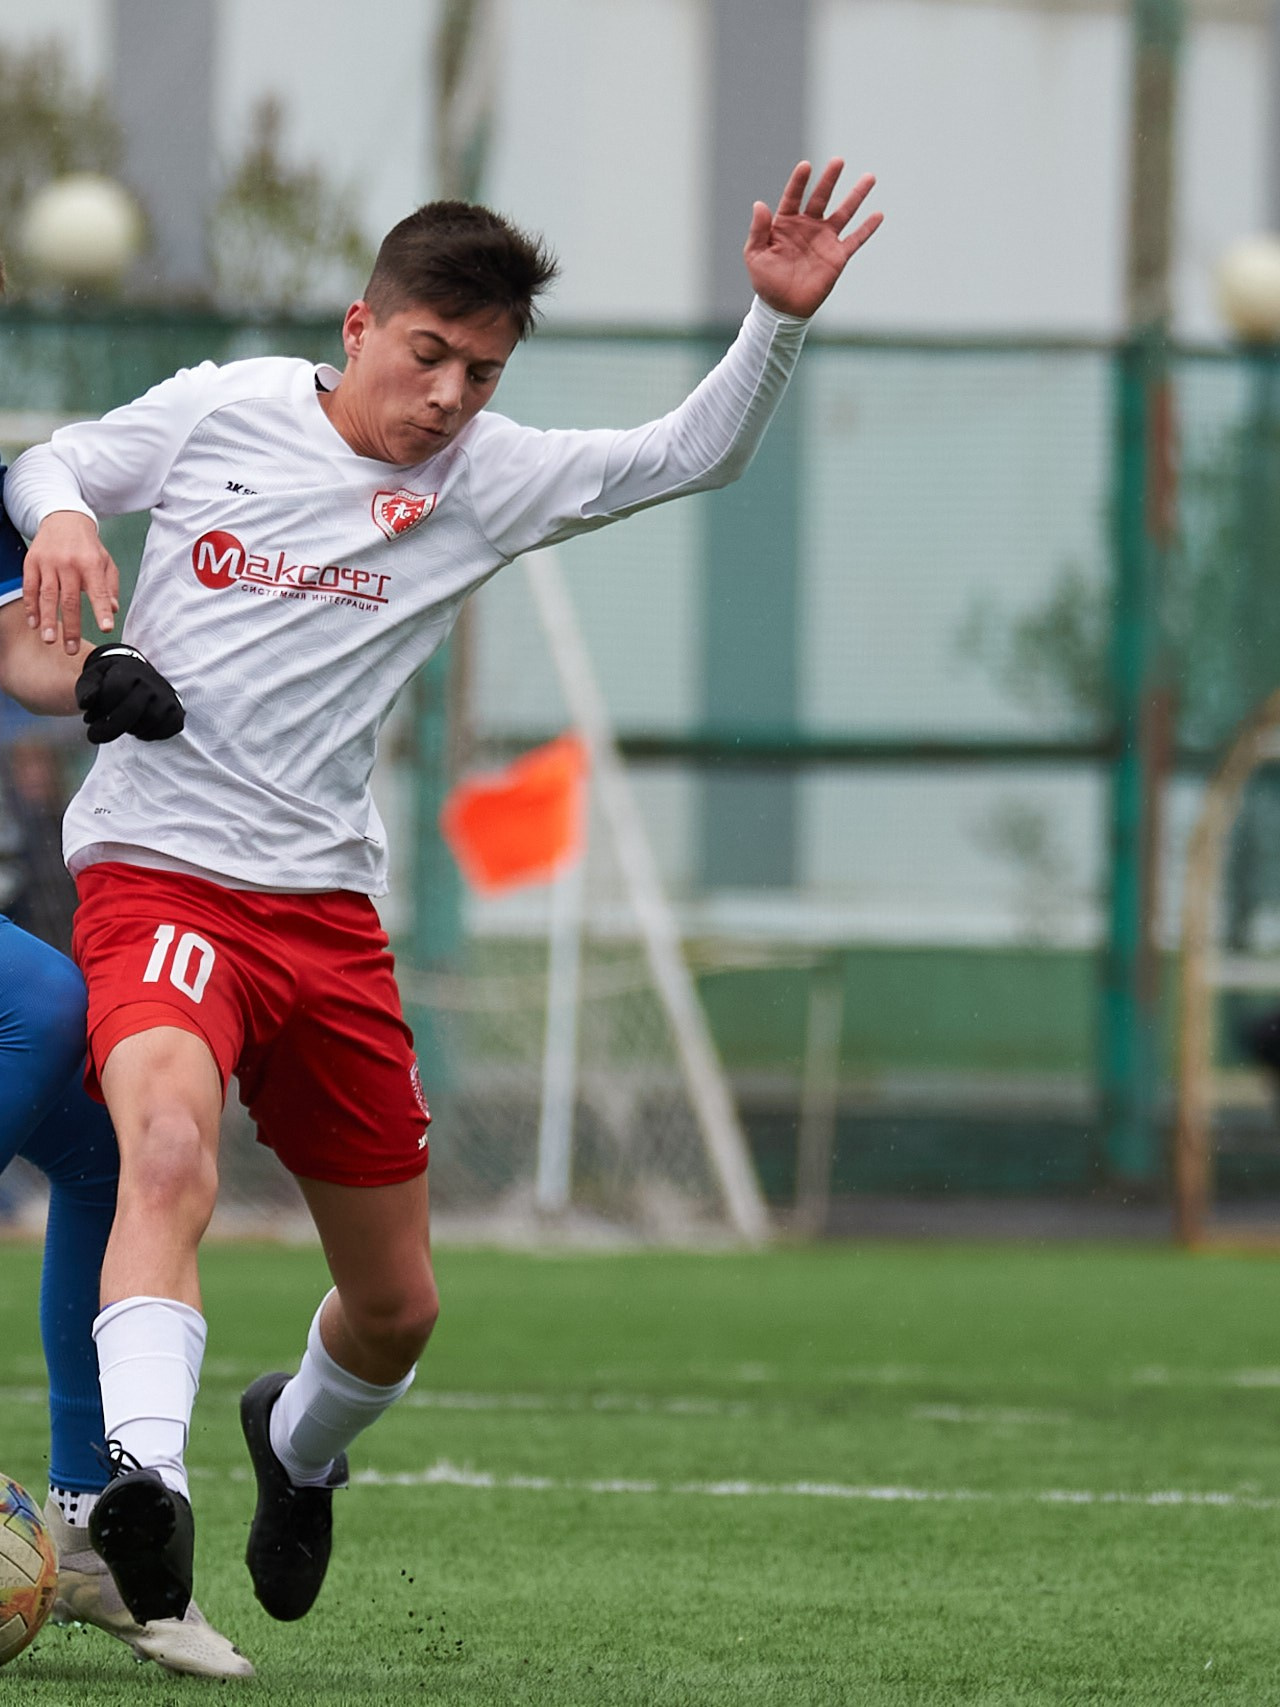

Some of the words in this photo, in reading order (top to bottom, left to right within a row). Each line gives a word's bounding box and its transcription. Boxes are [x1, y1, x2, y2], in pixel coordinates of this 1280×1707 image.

[240, 584, 307, 600] СИСТЕМНАЯ
[311, 594, 380, 612] ИНТЕГРАЦИЯ
[143, 924, 216, 1004] 10
